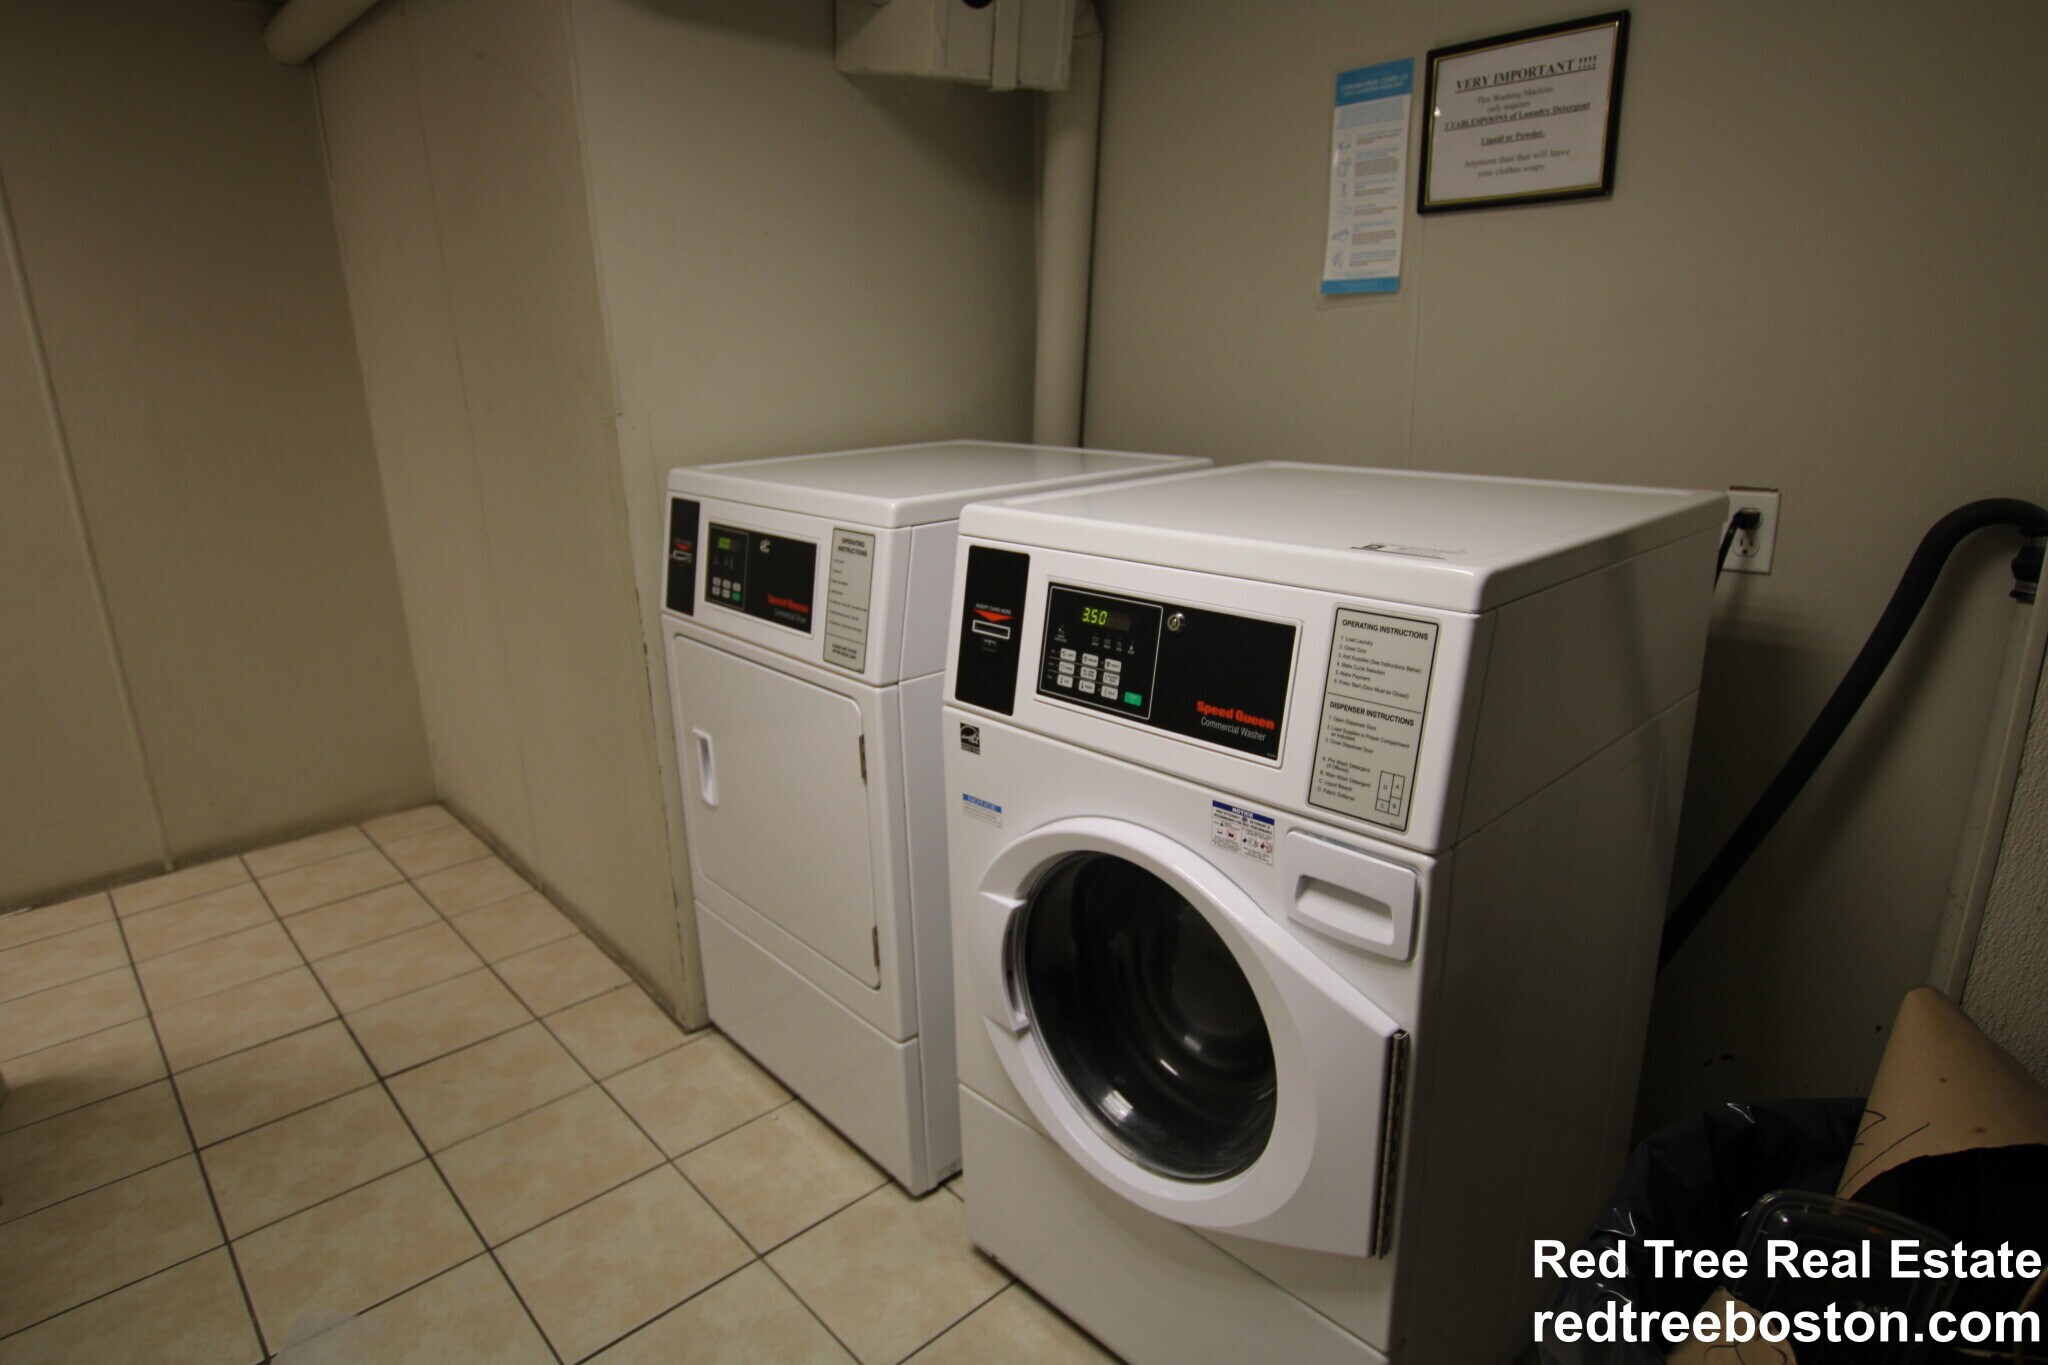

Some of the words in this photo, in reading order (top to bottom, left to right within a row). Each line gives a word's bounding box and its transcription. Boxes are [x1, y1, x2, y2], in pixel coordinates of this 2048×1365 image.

[1455, 74, 1492, 91] VERY
[1493, 60, 1575, 84] IMPORTANT
[1578, 55, 1598, 70] !!!!
[1477, 96, 1491, 104] This
[1493, 92, 1521, 104] Washing
[1524, 86, 1554, 97] Machine
[1487, 105, 1501, 114] only
[1503, 101, 1530, 112] requires
[1450, 113, 1508, 130] TABLESPOONS
[1510, 112, 1517, 121] of
[1519, 108, 1550, 121] Laundry
[1553, 102, 1591, 116] Detergent
[1481, 135, 1504, 146] Liquid
[1506, 134, 1514, 142] or
[1516, 130, 1546, 141] Powder.
[1464, 158, 1497, 169] Anymore
[1499, 154, 1515, 163] than
[1517, 152, 1531, 162] that
[1533, 150, 1547, 160] will
[1550, 149, 1570, 158] leave
[1477, 169, 1493, 179] your
[1495, 165, 1521, 175] clothes
[841, 537, 865, 548] OPERATING
[837, 546, 868, 557] INSTRUCTIONS
[1082, 607, 1108, 626] 3.50
[1342, 619, 1378, 632] OPERATING
[1380, 626, 1429, 640] INSTRUCTIONS
[1356, 638, 1374, 647] Laundry
[1352, 655, 1370, 664] Supplies
[1370, 658, 1380, 666] (See
[1381, 661, 1405, 671] Instructions
[1406, 665, 1422, 675] Below)
[1366, 667, 1385, 675] Selection
[1352, 673, 1371, 681] Payment
[1338, 679, 1351, 687] Press
[1362, 684, 1373, 692] (Door
[1196, 700, 1234, 719] Speed
[1235, 710, 1276, 730] Queen
[1330, 701, 1365, 715] DISPENSER
[1366, 709, 1415, 727] INSTRUCTIONS
[1201, 716, 1240, 734] Commercial
[1241, 727, 1267, 742] Washer
[1333, 716, 1345, 724] Open
[1345, 718, 1366, 729] Dispenser
[1332, 725, 1342, 733] Load
[1343, 728, 1360, 737] Supplies
[1365, 733, 1379, 742] Proper
[1380, 737, 1410, 749] Compartment
[1340, 733, 1355, 742] Indicated
[1330, 738, 1341, 746] Close
[1342, 741, 1362, 751] Dispenser
[1363, 746, 1374, 754] Door
[1349, 762, 1371, 773] Detergent
[1324, 779, 1337, 788] Liquid
[1337, 783, 1353, 792] Bleach
[1336, 774, 1349, 782] Wash
[1350, 777, 1371, 788] Detergent
[1323, 787, 1336, 796] Fabric
[1337, 791, 1355, 801] Softener
[1232, 807, 1254, 819] NOTICE
